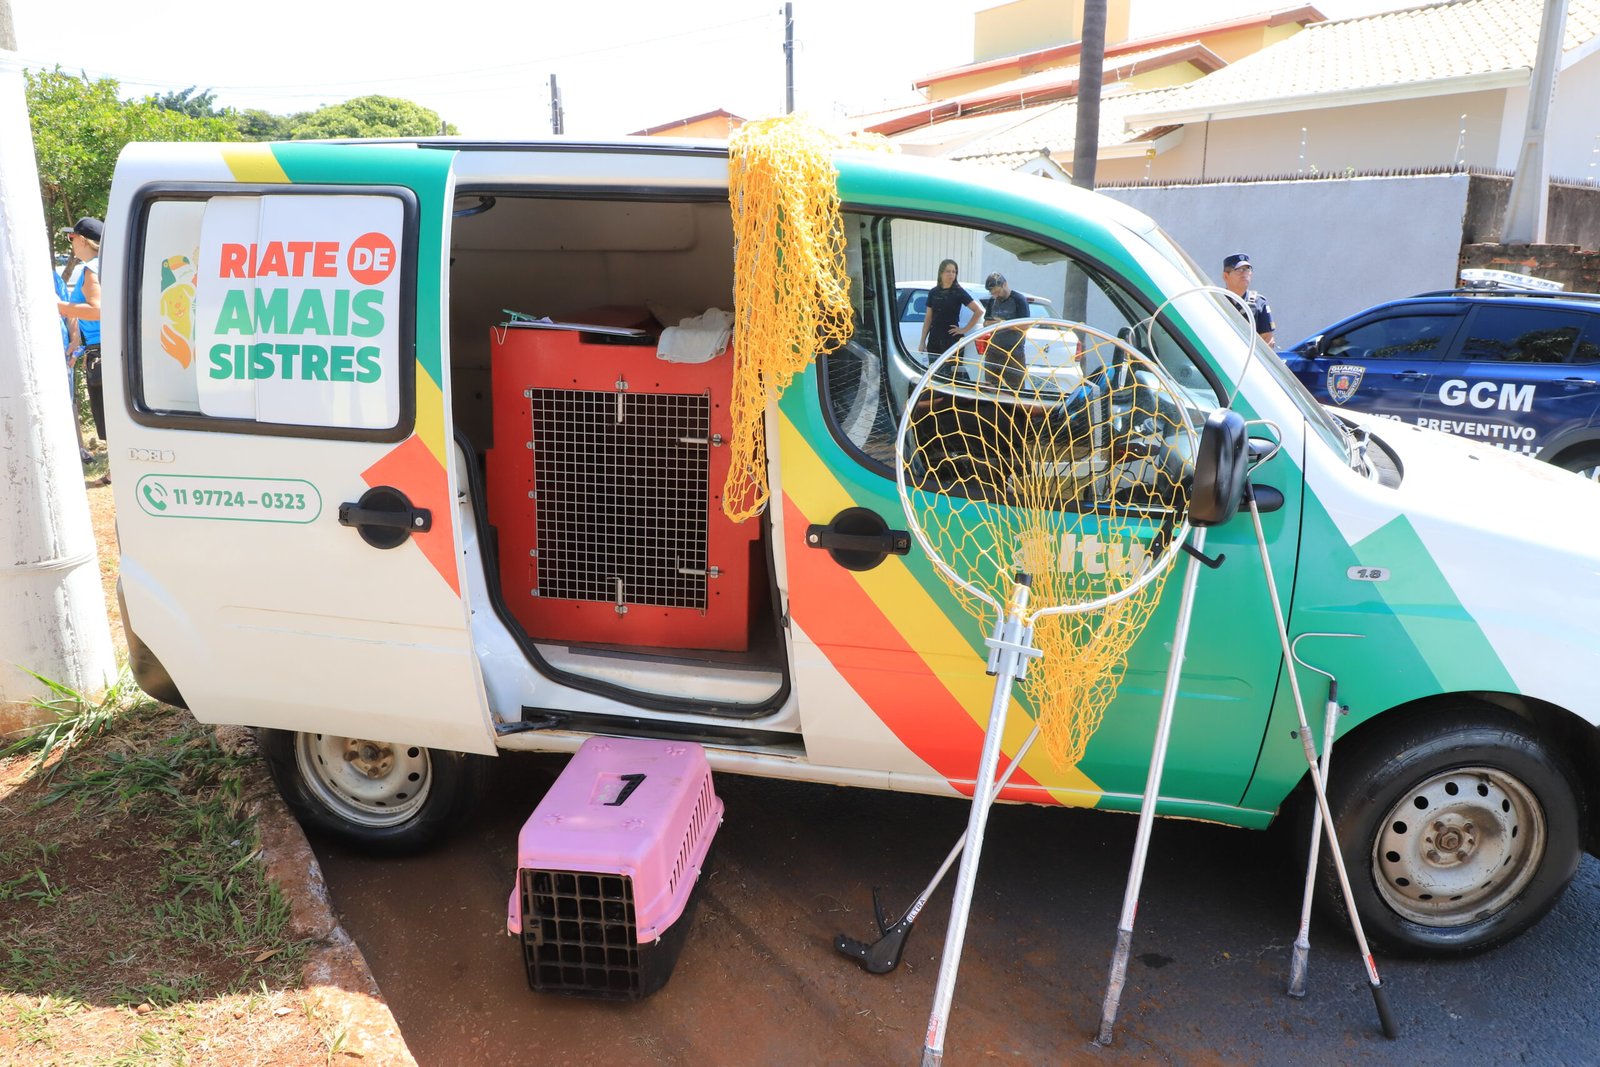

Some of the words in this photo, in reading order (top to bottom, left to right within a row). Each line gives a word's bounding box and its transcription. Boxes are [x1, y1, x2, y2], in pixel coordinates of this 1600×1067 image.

[353, 247, 391, 271] DE
[1438, 379, 1536, 412] GCM
[1417, 417, 1537, 441] PREVENTIVO
[173, 489, 188, 505] 11
[1059, 533, 1146, 576] Itu
[1357, 569, 1382, 579] 1.8
